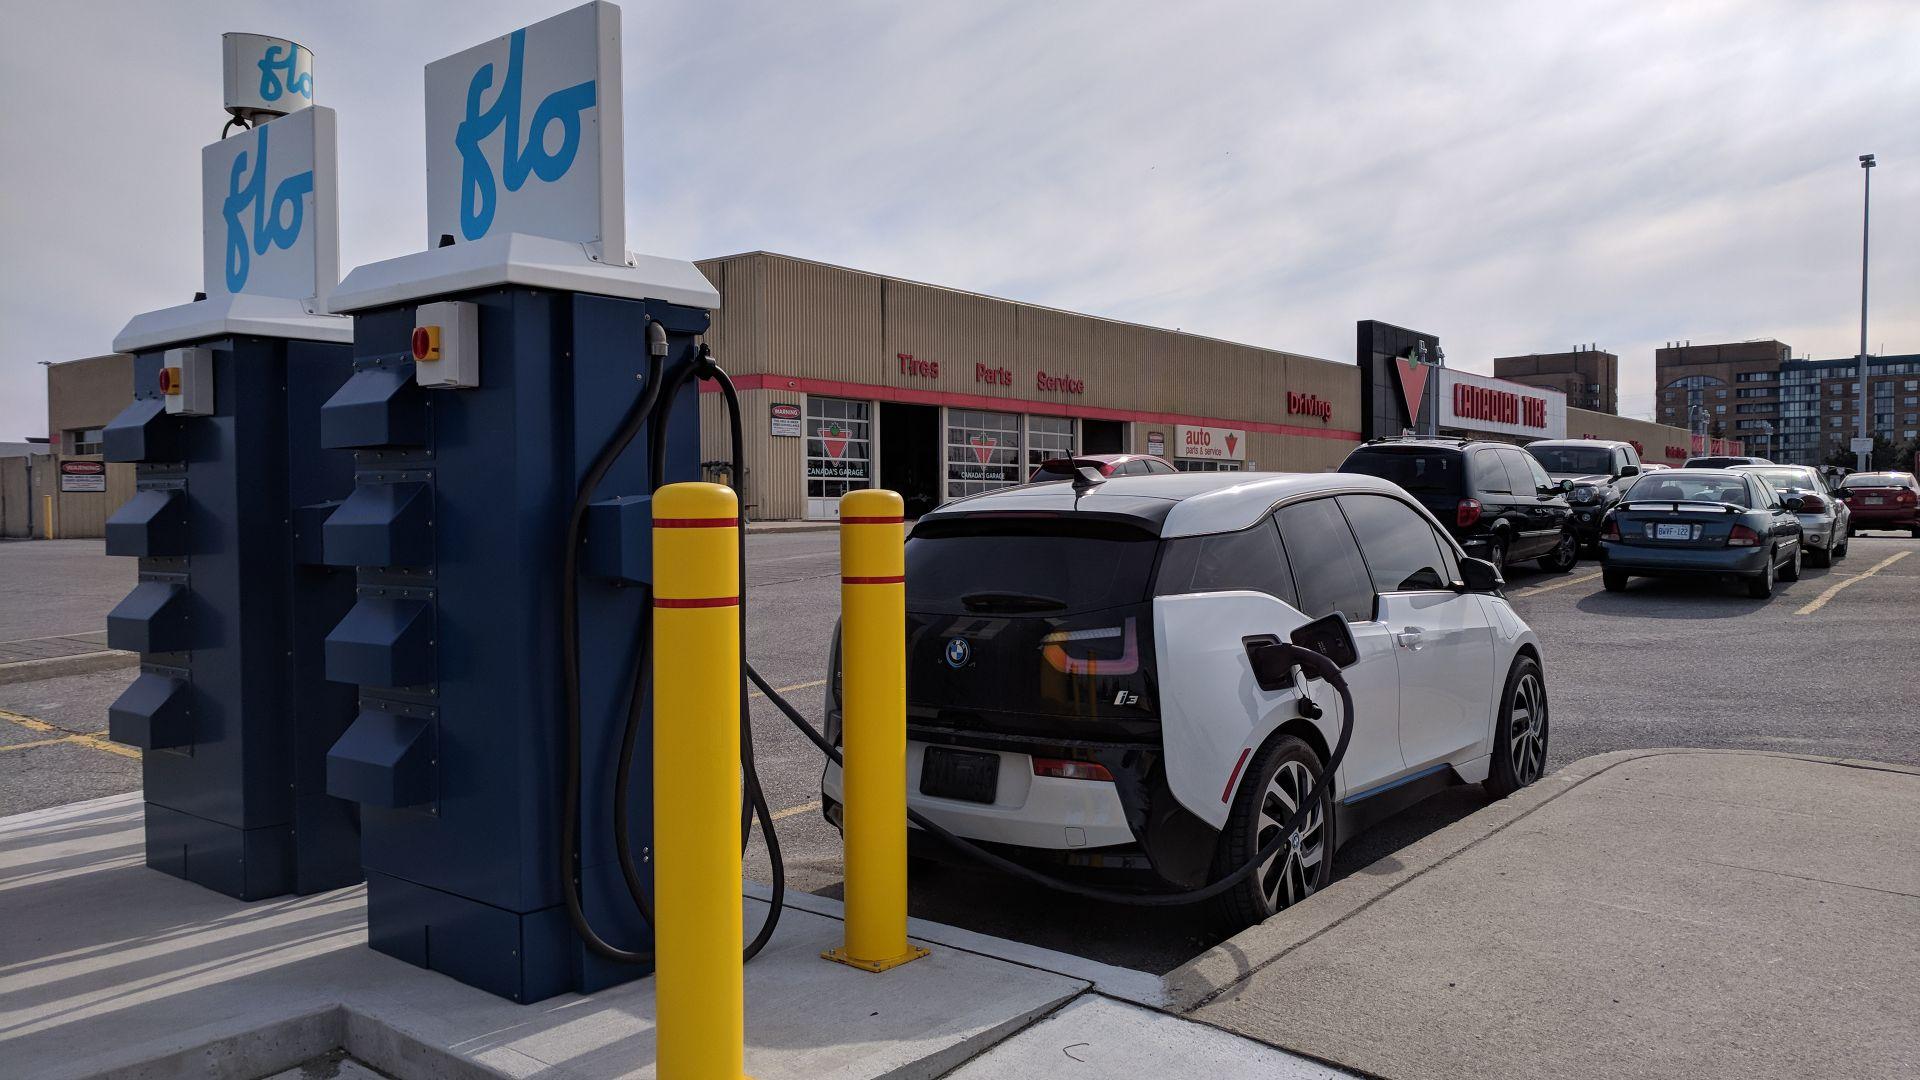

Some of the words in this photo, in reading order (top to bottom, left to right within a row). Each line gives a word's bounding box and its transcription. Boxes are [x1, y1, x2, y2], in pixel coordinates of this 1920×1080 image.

[257, 42, 312, 102] flo
[455, 27, 597, 241] flo
[223, 124, 313, 293] flo
[897, 353, 940, 379] Tires
[976, 362, 1013, 385] Parts
[1037, 371, 1085, 393] Service
[774, 408, 798, 416] WARNING
[1287, 391, 1332, 423] Driving
[1453, 383, 1520, 425] CANADIAN
[1522, 395, 1548, 428] TIRE
[1185, 428, 1211, 446] auto
[1185, 446, 1199, 456] parts
[1205, 447, 1222, 456] service
[808, 467, 838, 476] CANADA'S
[838, 468, 863, 477] GARAGE
[1113, 690, 1139, 706] i3
